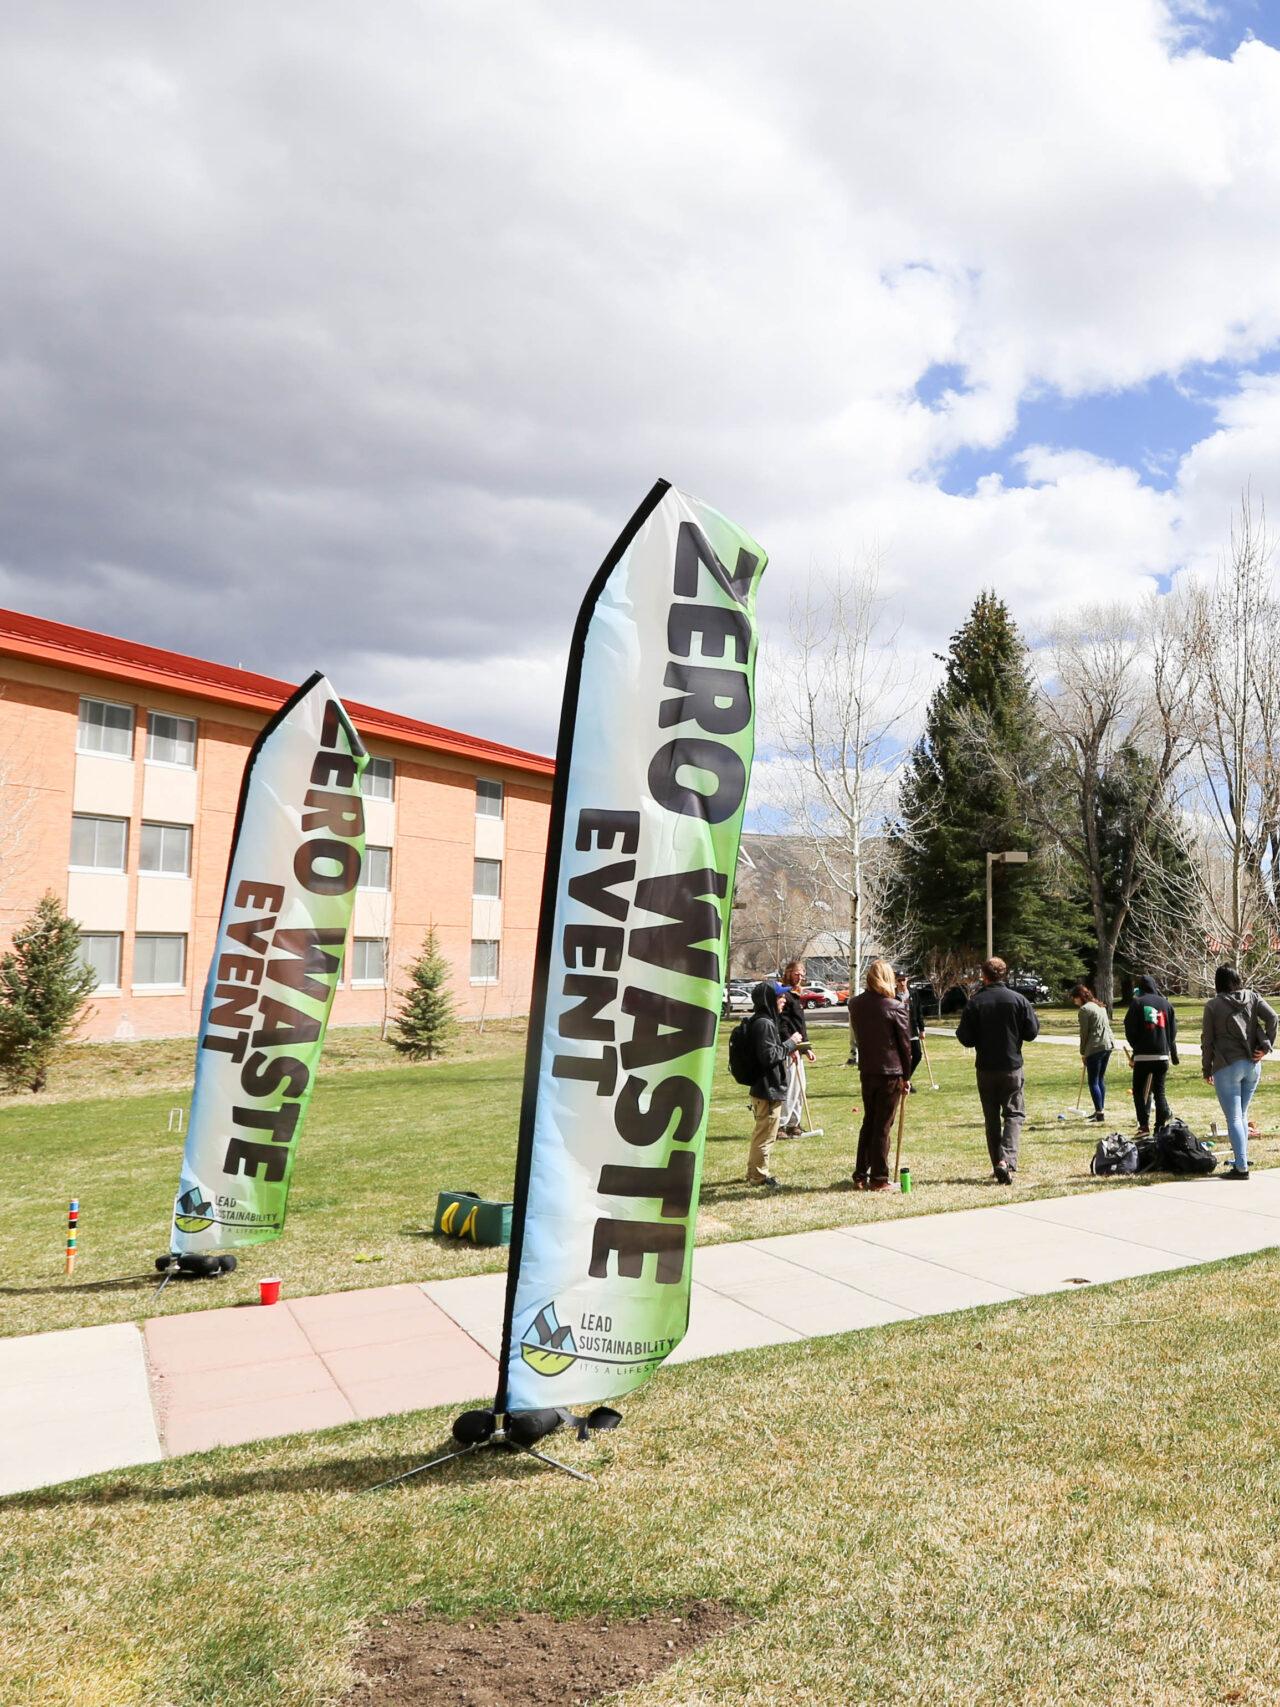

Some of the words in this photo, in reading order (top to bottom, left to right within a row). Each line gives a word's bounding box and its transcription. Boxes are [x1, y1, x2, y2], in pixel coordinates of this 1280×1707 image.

[648, 521, 759, 825] ZERO
[202, 879, 285, 1064] EVENT
[551, 808, 640, 1099] EVENT
[223, 927, 347, 1183] WASTE
[587, 866, 728, 1286] WASTE
[215, 1195, 237, 1208] LEAD
[579, 1336, 675, 1355] SUSTAINABILITY
[580, 1362, 599, 1373] IT'S
[605, 1367, 611, 1375] A
[616, 1363, 657, 1376] LIFEST
[581, 1313, 612, 1333] LEAD
